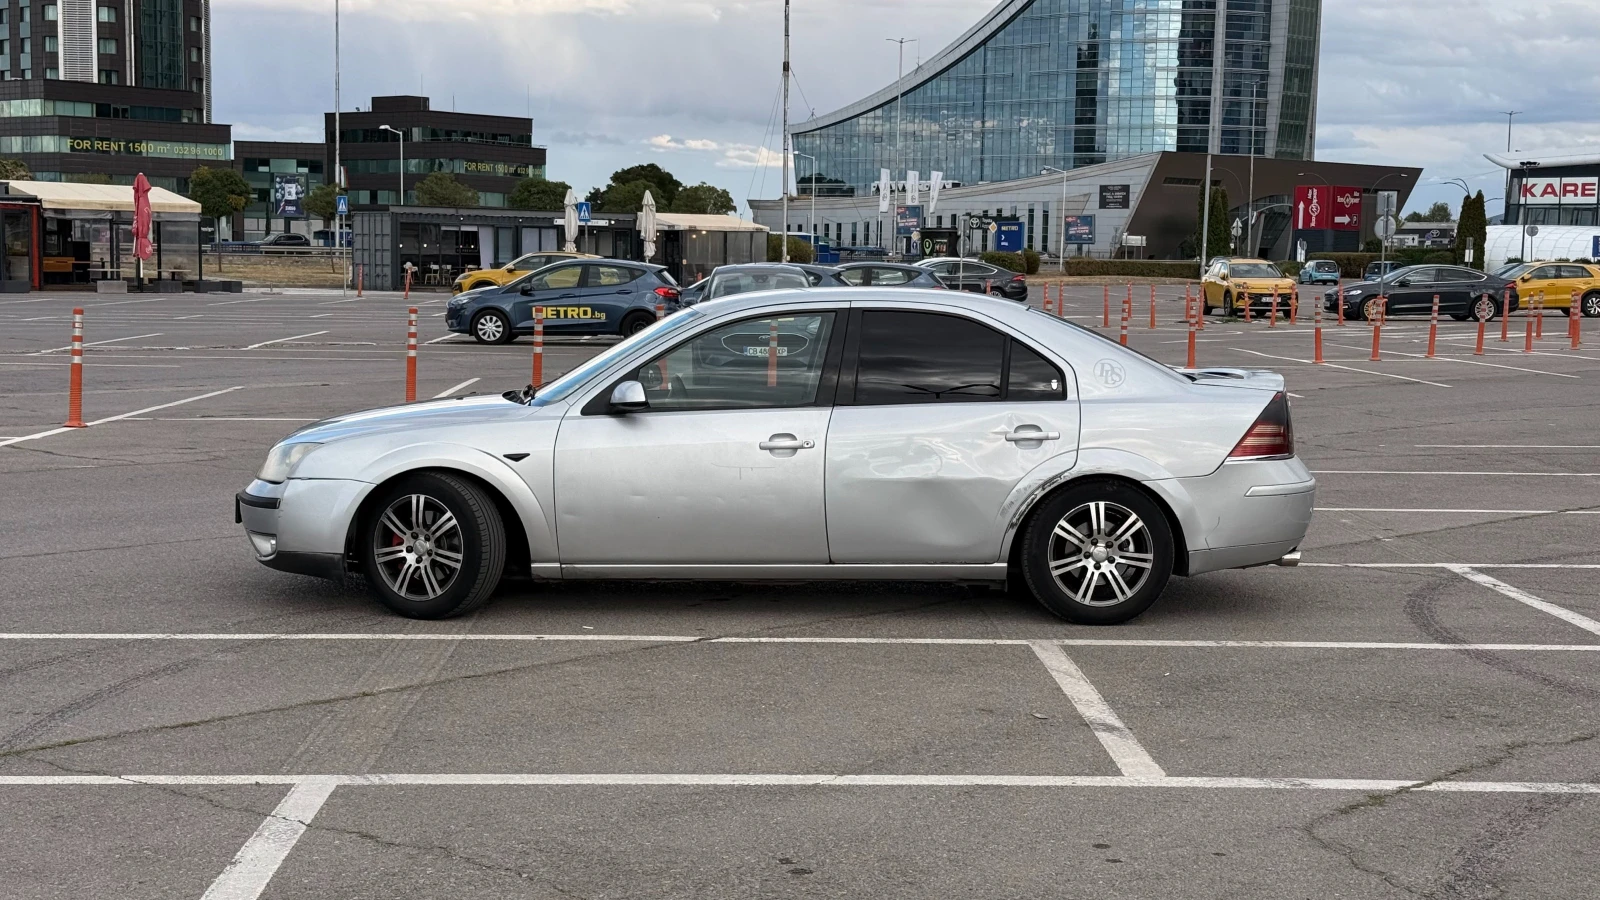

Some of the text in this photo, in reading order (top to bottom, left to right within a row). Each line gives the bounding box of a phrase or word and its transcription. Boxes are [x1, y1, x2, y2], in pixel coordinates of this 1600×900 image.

[67, 139, 91, 150] FOR
[95, 140, 126, 152] RENT
[128, 142, 154, 153] 1500
[174, 146, 188, 154] 032
[203, 148, 223, 156] 1000
[463, 161, 476, 171] FOR
[478, 162, 493, 172] RENT
[495, 164, 508, 173] 1500
[1521, 182, 1597, 198] KARE
